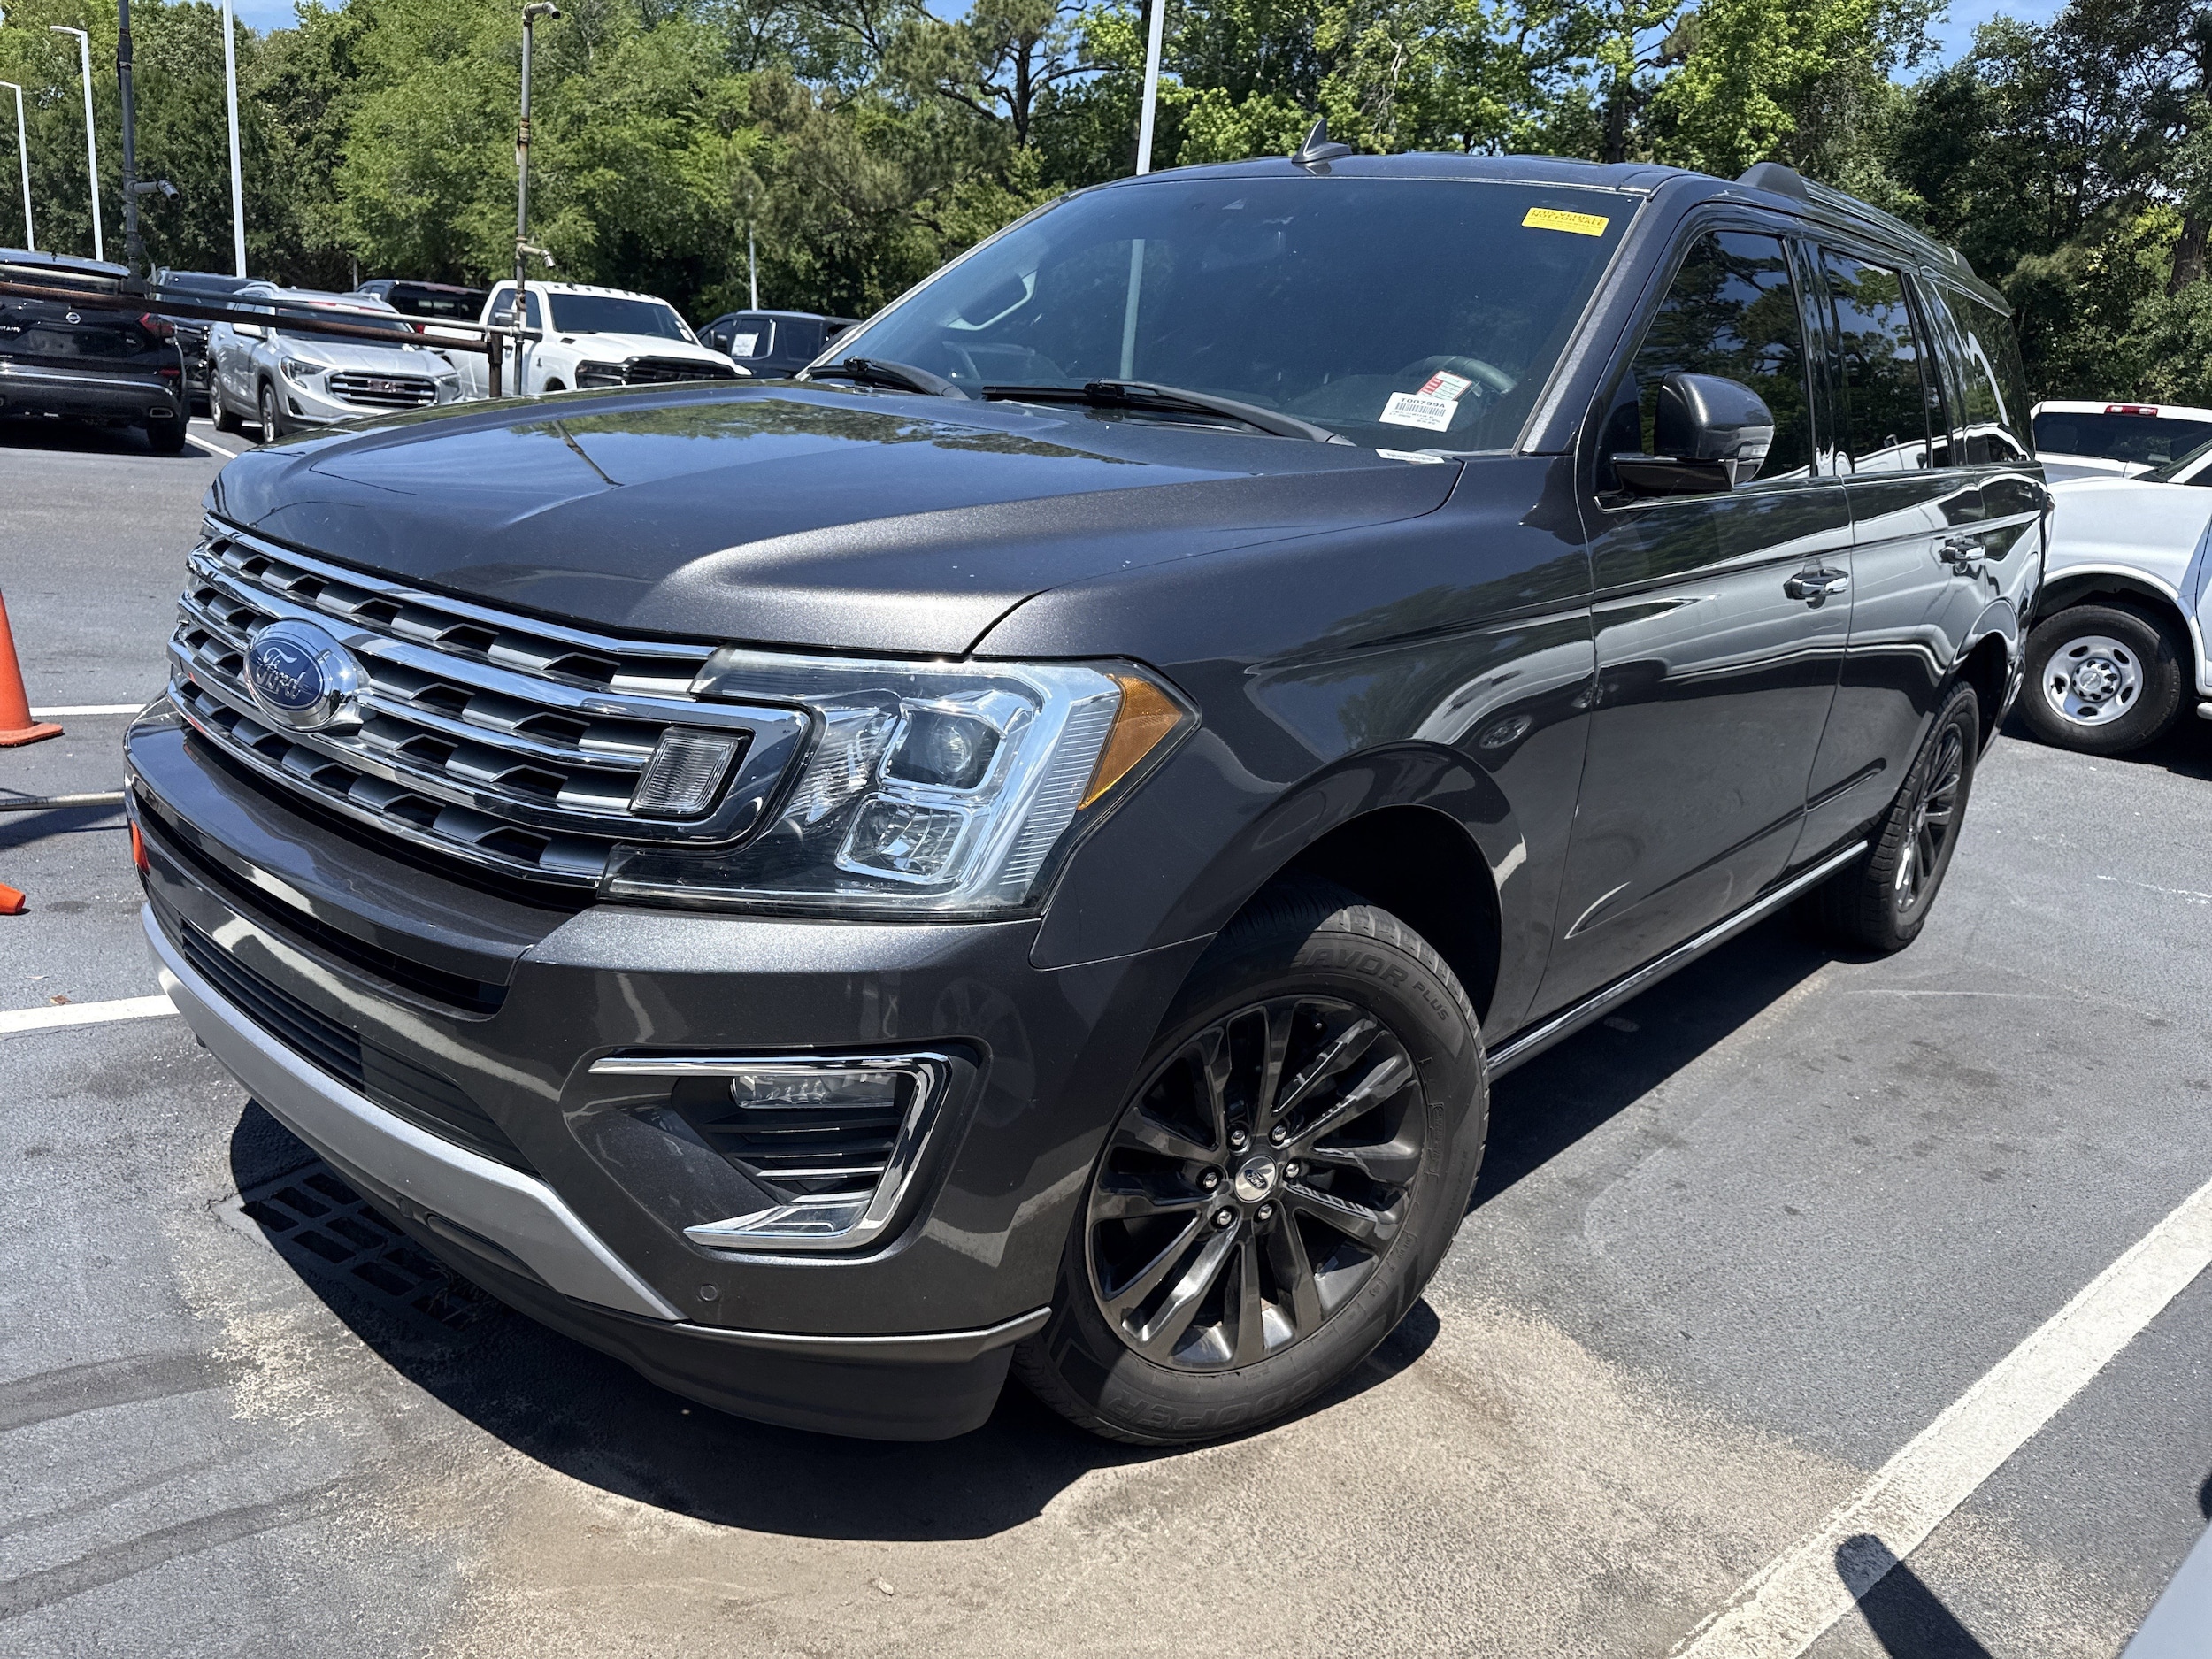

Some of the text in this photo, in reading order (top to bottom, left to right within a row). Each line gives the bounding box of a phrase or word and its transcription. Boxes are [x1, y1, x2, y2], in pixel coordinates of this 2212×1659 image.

[255, 646, 307, 700] Ford
[1411, 980, 1449, 1022] PLUS
[1246, 1170, 1266, 1188] Ford
[1108, 1370, 1320, 1432] COOPER
